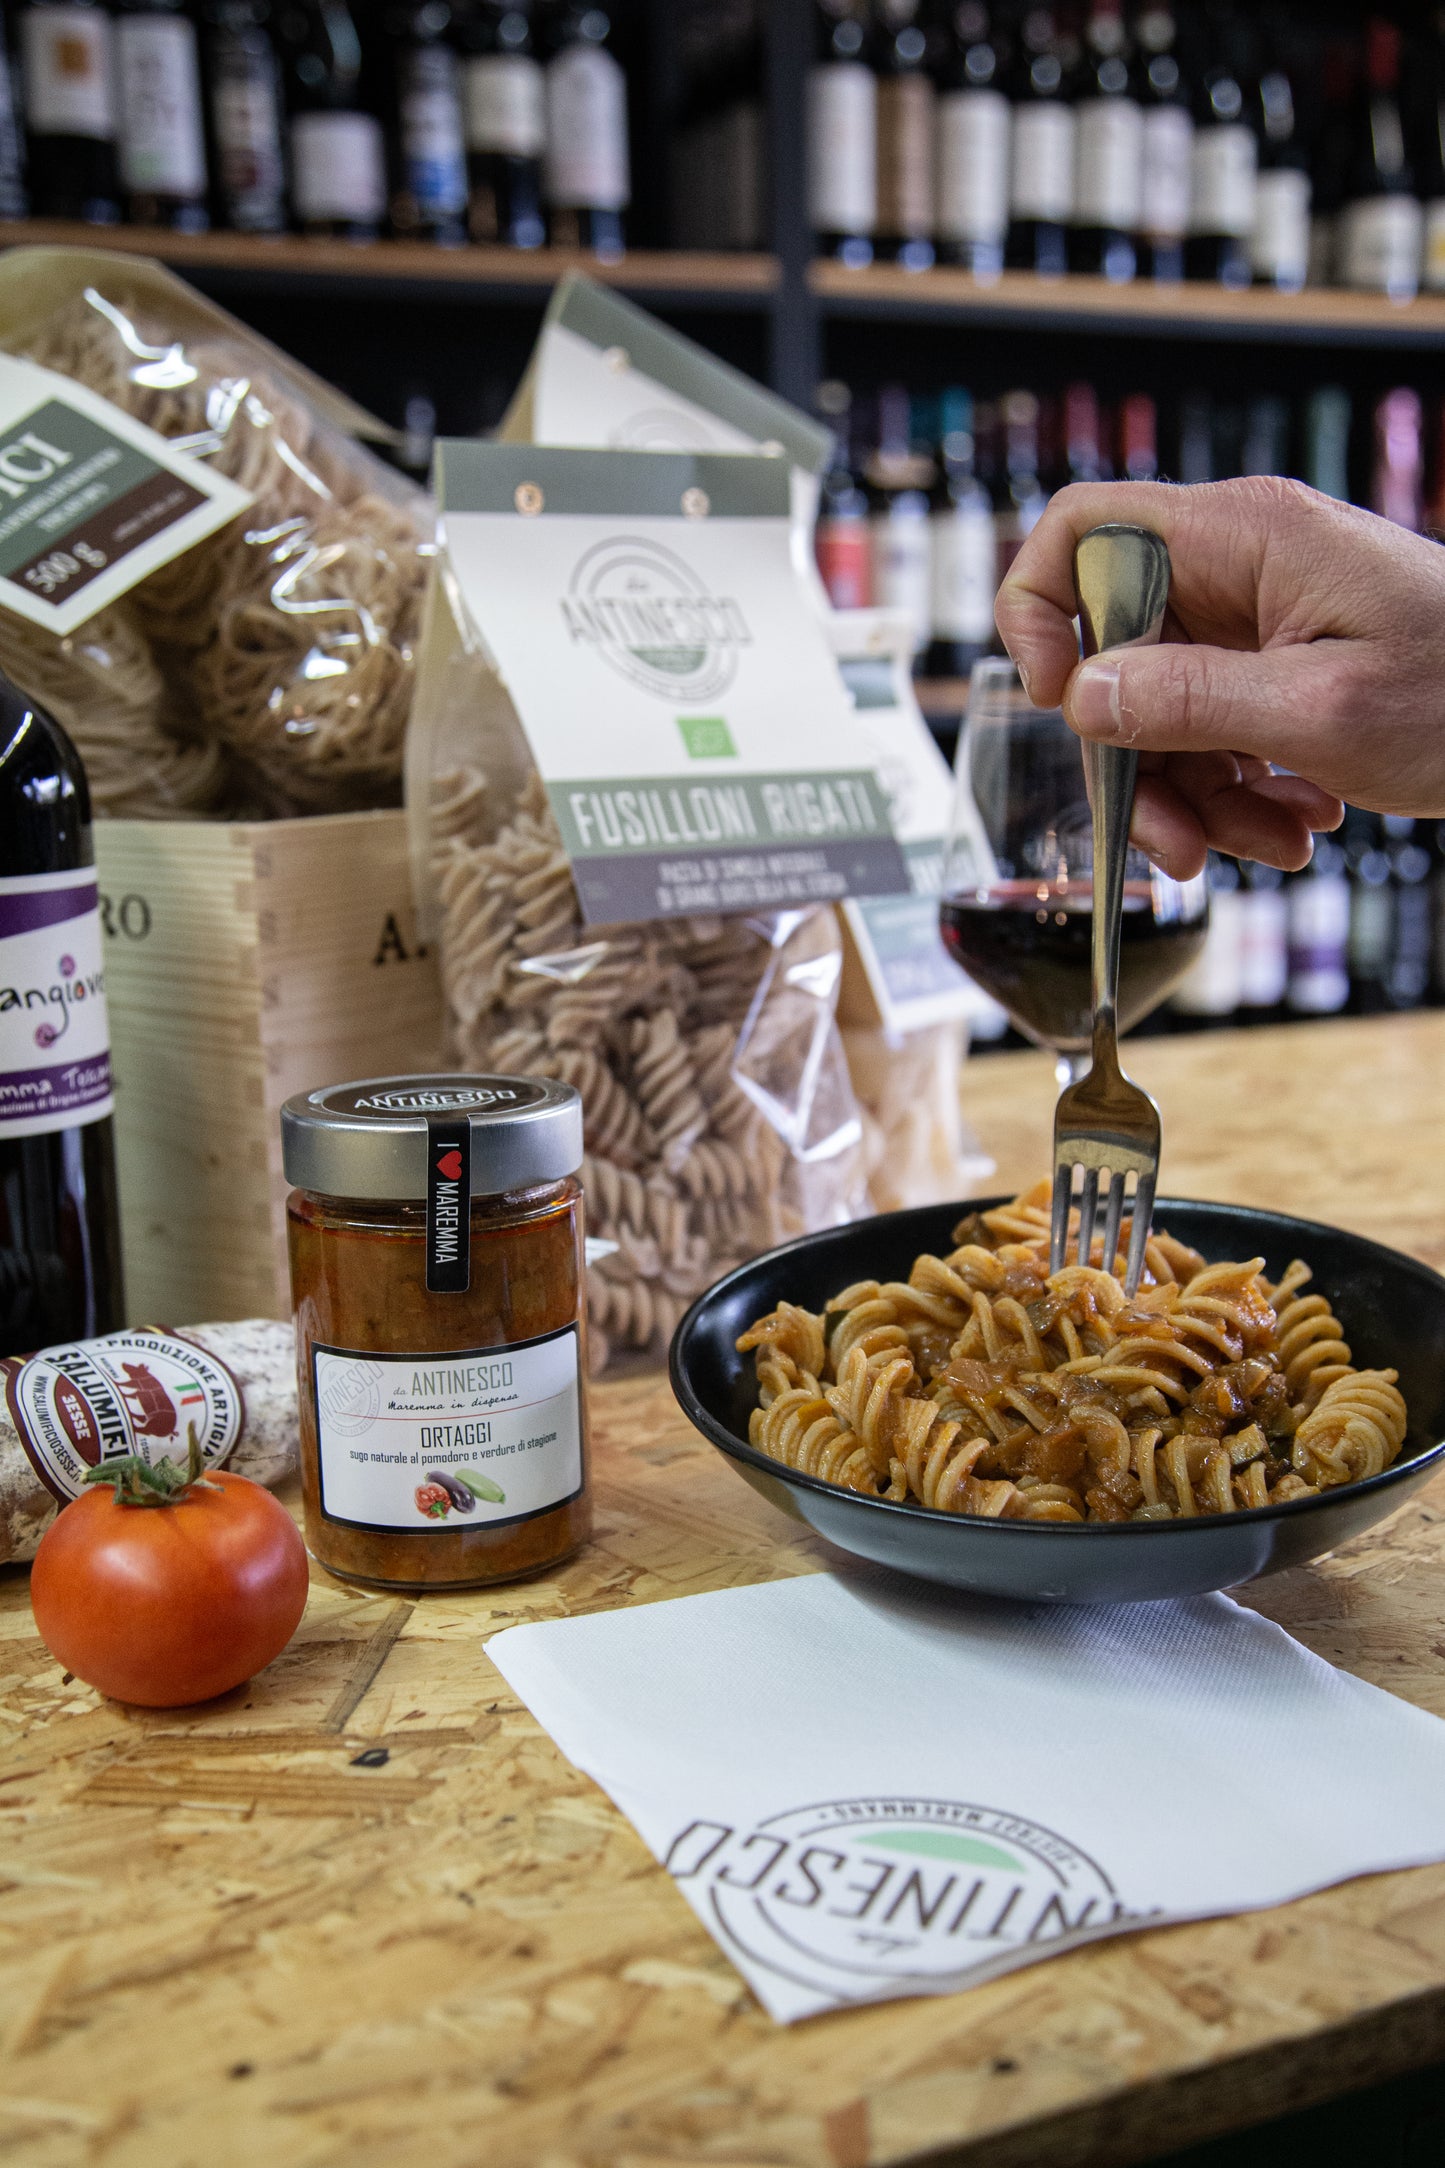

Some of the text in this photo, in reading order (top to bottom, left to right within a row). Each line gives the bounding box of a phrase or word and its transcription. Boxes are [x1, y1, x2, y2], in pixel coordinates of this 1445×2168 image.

[24, 541, 107, 594] 500 g
[570, 786, 757, 848] FUSILLONI
[760, 779, 877, 835] RIGATI
[354, 1089, 517, 1109] ANTINESCO
[435, 1182, 459, 1264] MAREMMA
[106, 1338, 217, 1384] PRODUZIONE
[393, 1362, 513, 1396] da ANTINESCO
[44, 1351, 130, 1460] SALUMIFI
[61, 1394, 91, 1440] 3ESSE
[388, 1392, 520, 1411] Maremma in dispensa
[350, 1431, 557, 1466] sugo naturale al pomodoro e verdure di stagione
[421, 1422, 492, 1449] ORTAGGI
